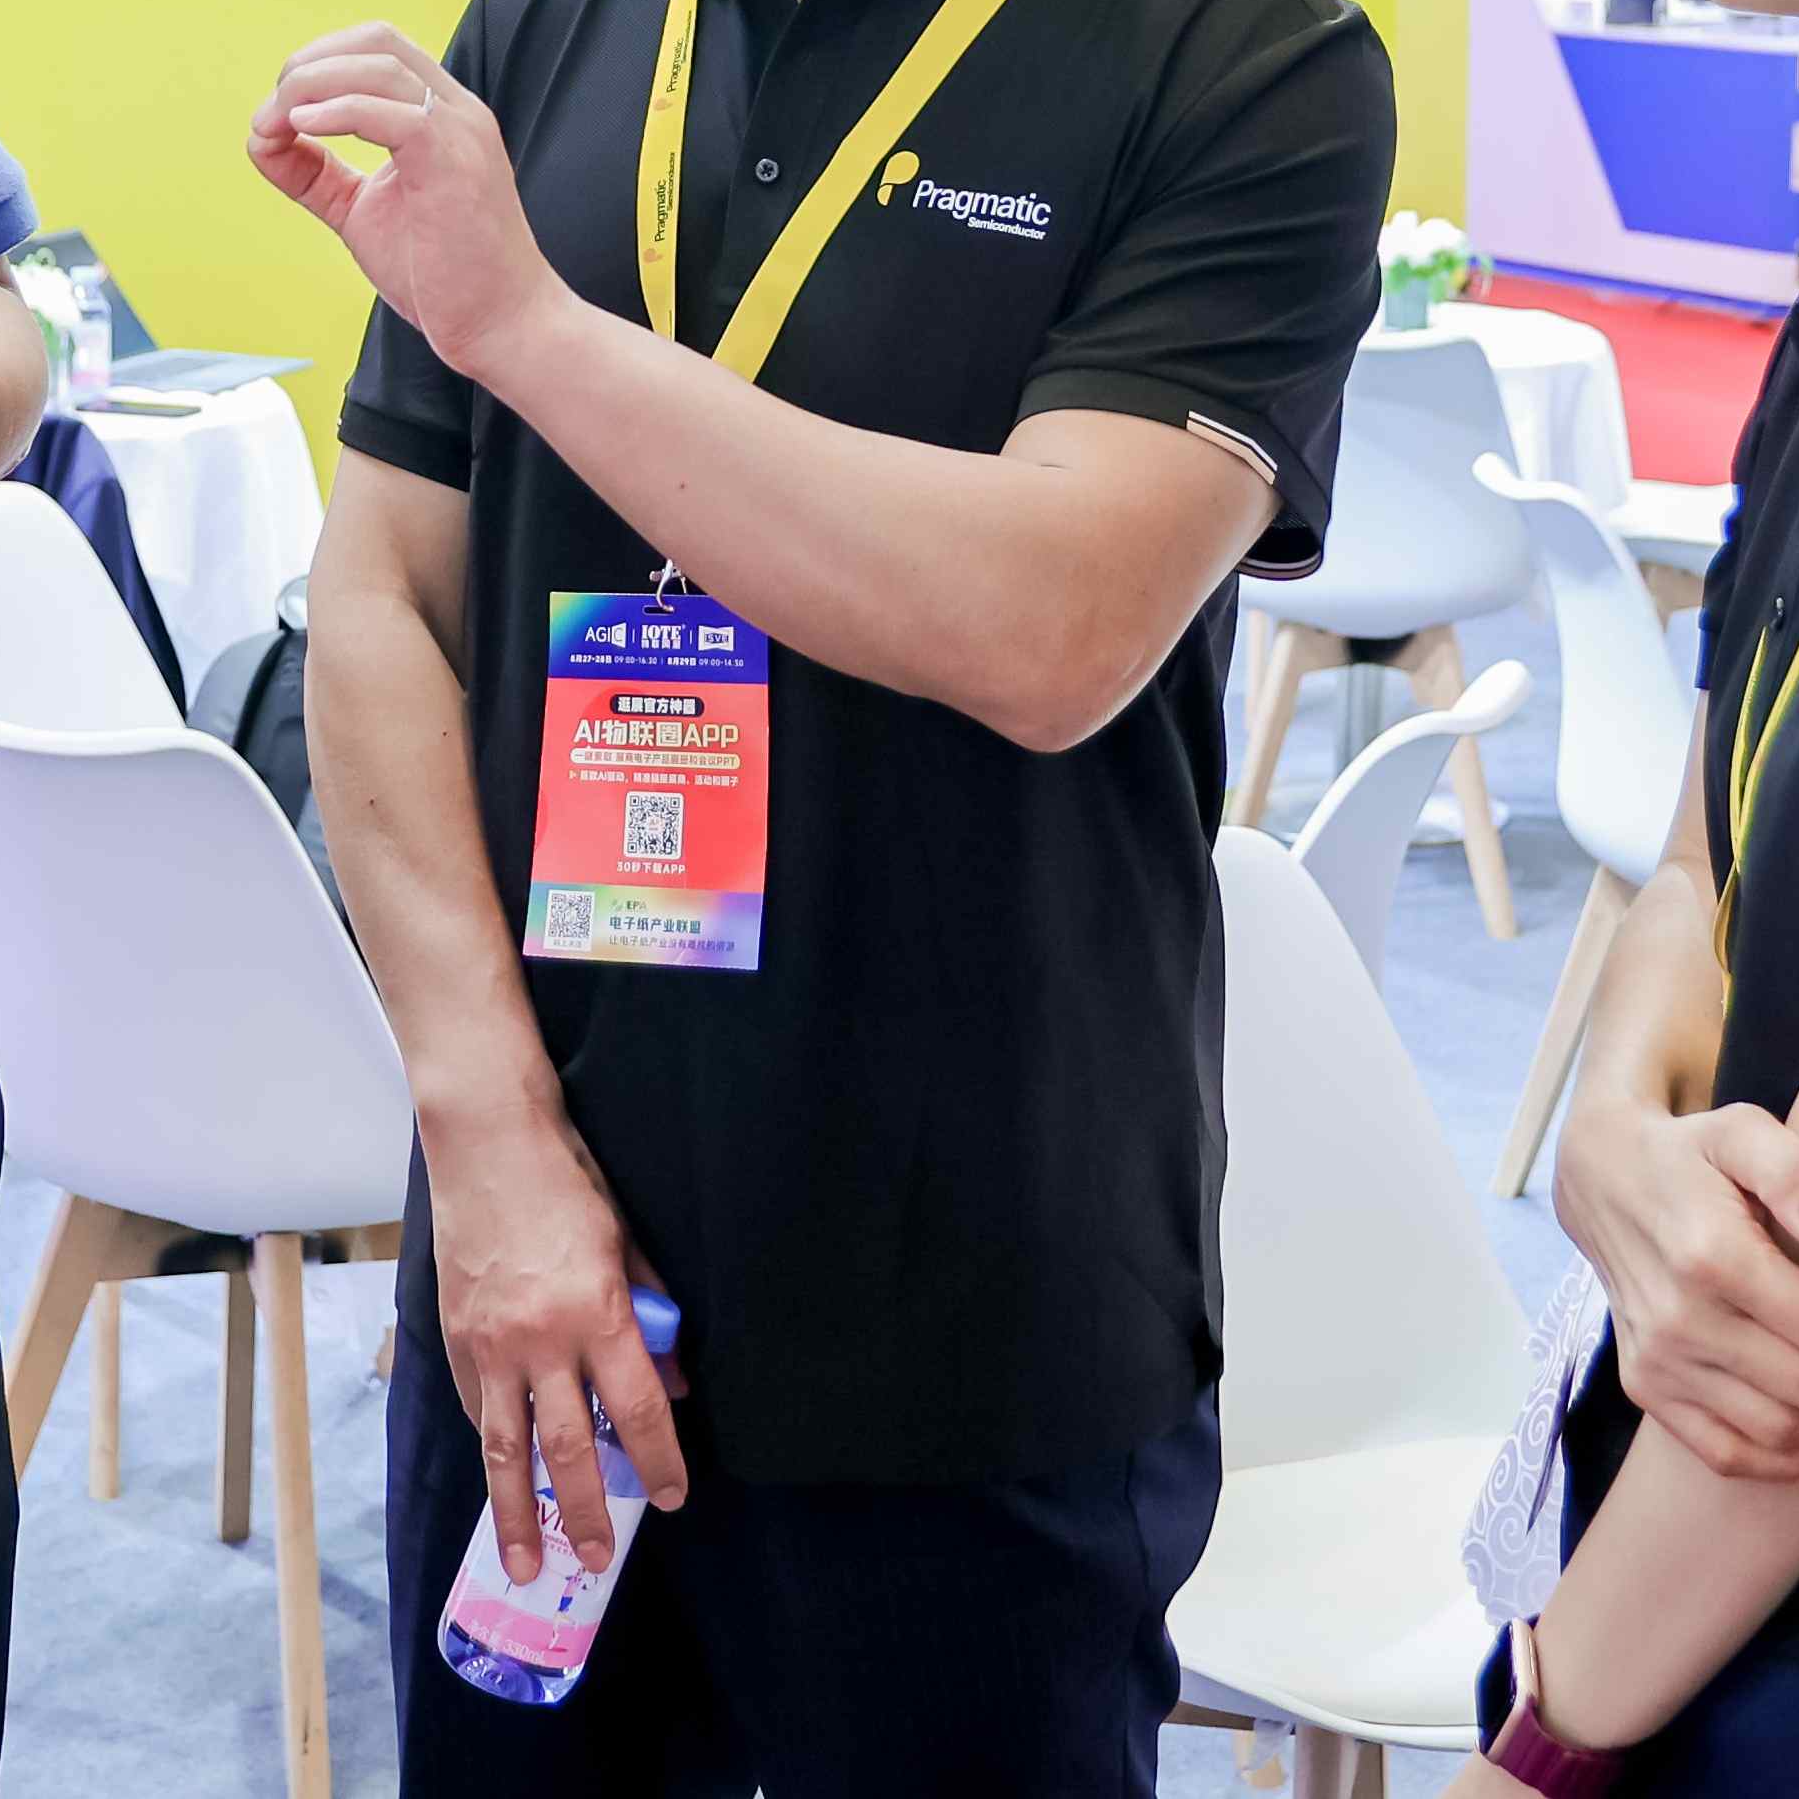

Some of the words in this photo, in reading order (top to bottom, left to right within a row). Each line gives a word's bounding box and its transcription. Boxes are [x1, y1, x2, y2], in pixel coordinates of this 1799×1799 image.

[654, 179, 667, 243] Pragmatic
[912, 179, 1051, 226] Pragmatic
[967, 216, 1047, 240] Semiconductor
[641, 624, 682, 639] IOTE
[573, 719, 739, 748] AI物联圈APP
[609, 915, 701, 935] 电子纸产业联盟
